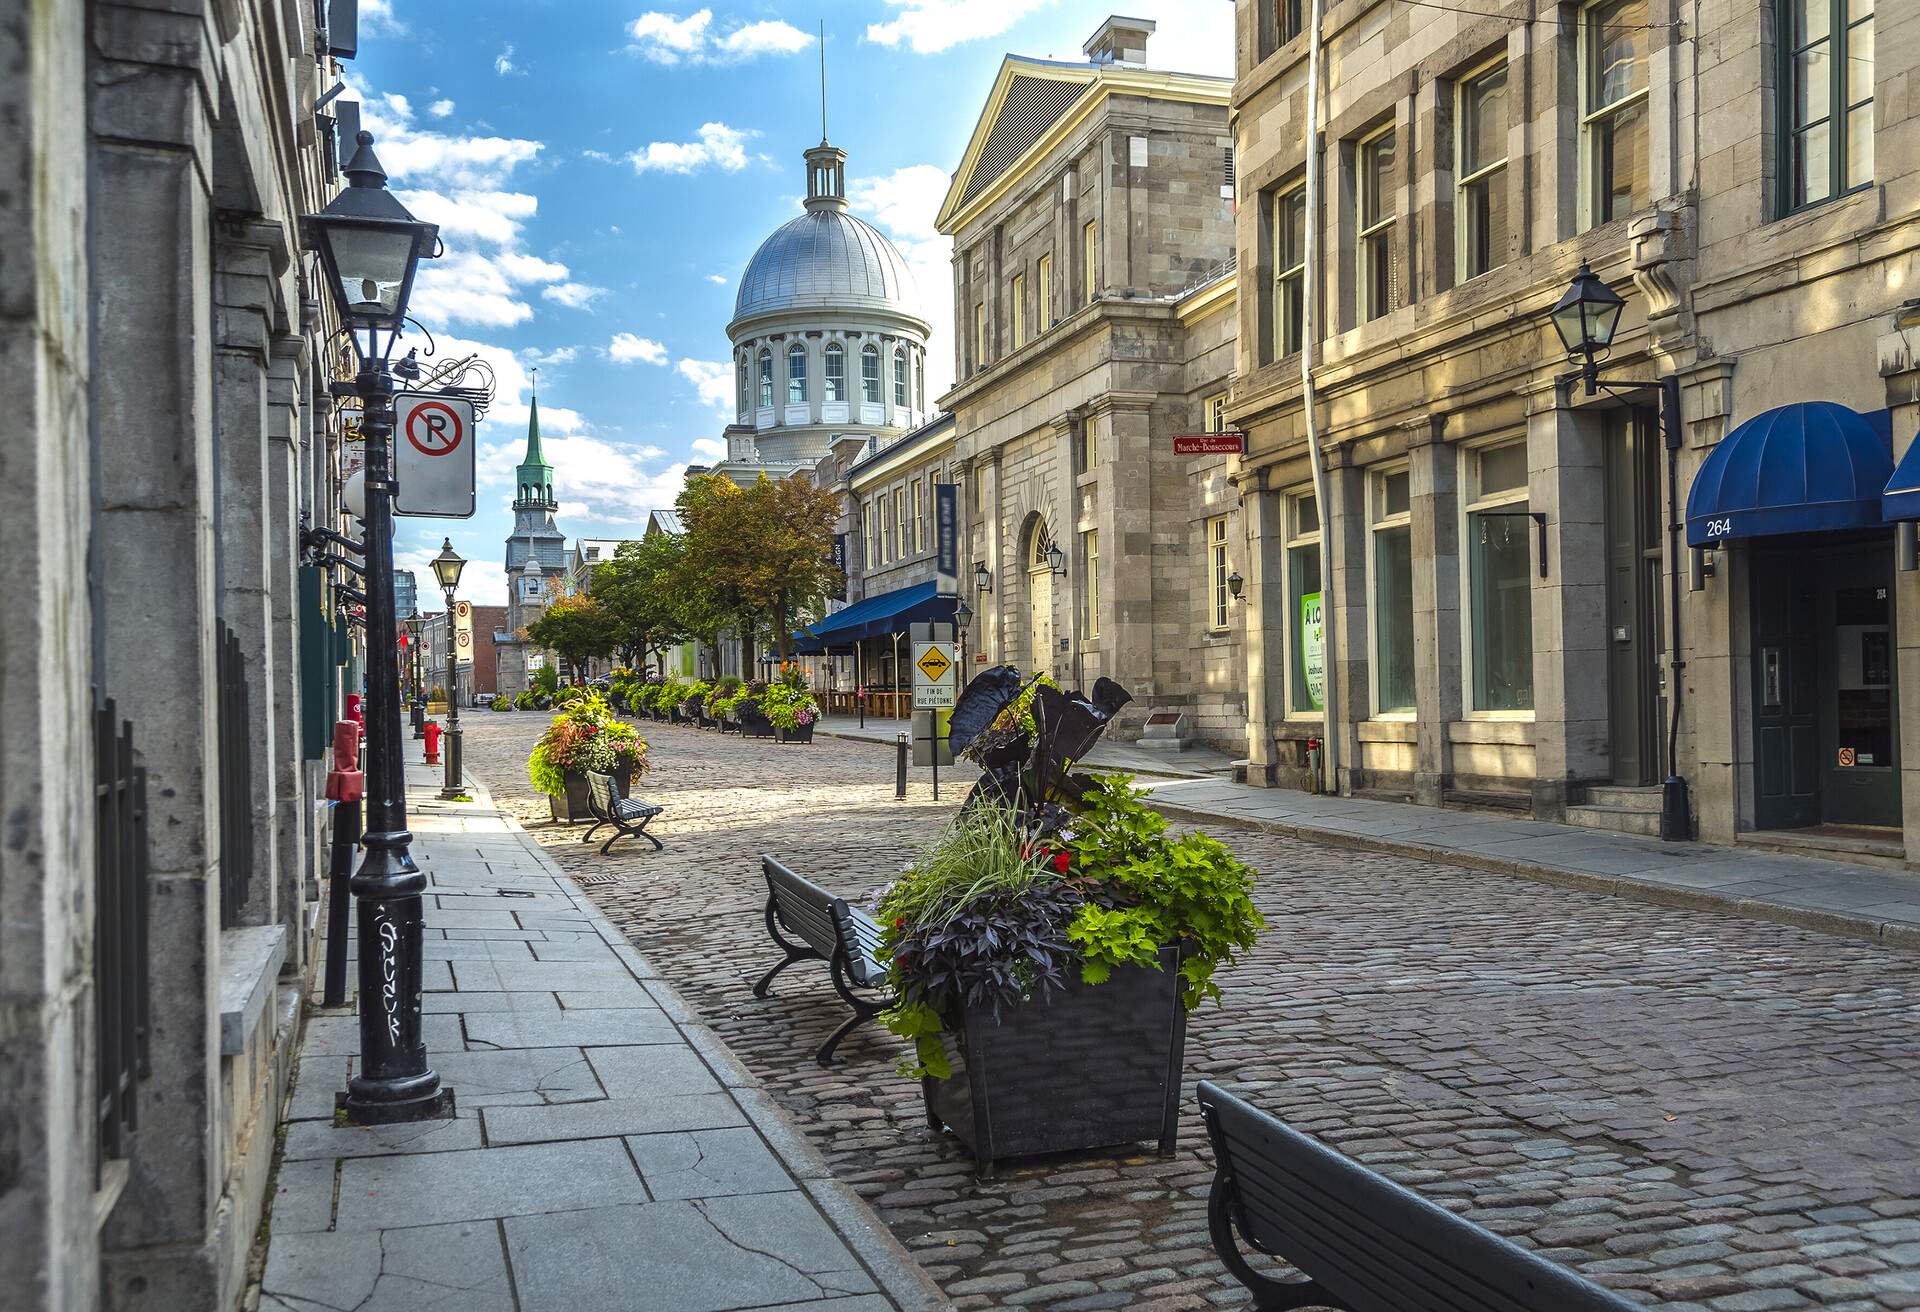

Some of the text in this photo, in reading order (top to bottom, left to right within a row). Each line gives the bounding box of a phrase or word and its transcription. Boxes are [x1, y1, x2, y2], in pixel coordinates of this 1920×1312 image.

[1706, 518, 1732, 537] 264
[917, 696, 953, 705] RUE PIÉTONNE
